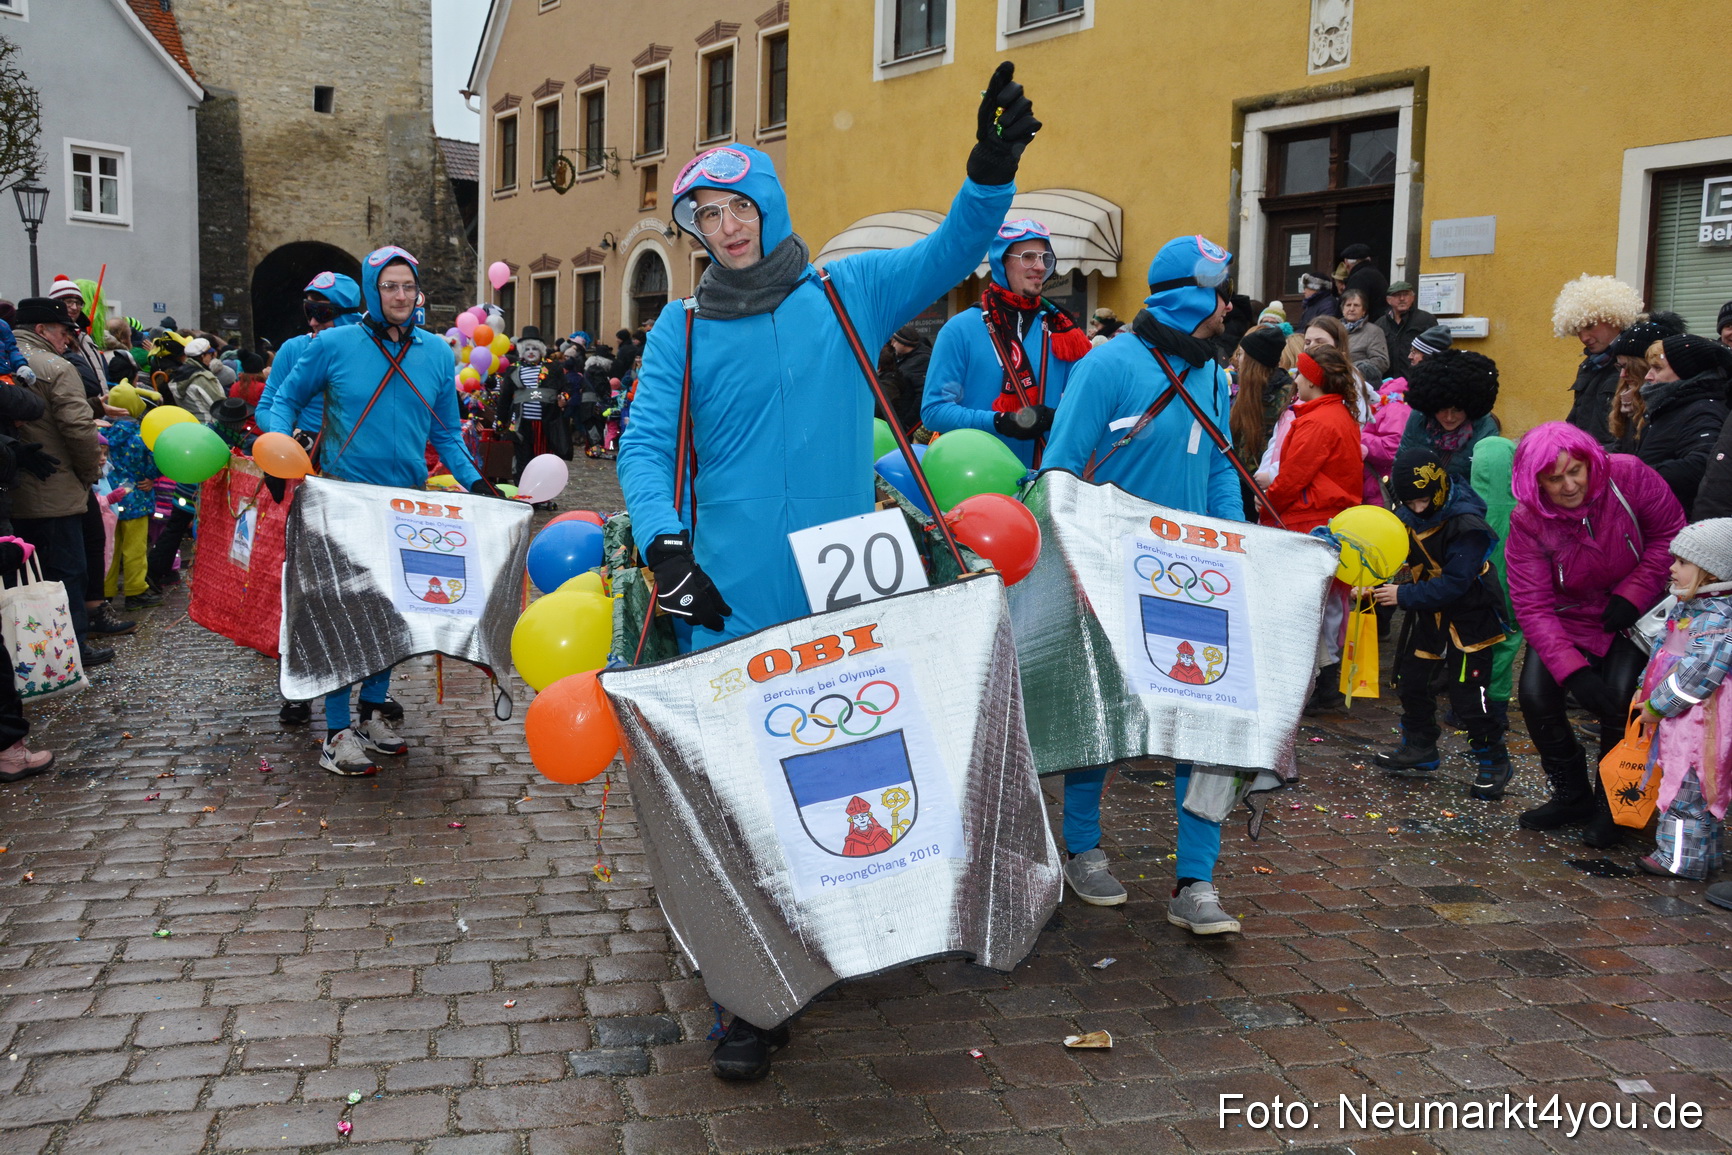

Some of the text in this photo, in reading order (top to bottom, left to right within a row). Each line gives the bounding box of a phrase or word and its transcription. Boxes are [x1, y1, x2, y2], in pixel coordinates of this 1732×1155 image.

[390, 498, 464, 520] OBI
[395, 515, 424, 526] Berching
[437, 521, 462, 530] Olympia
[1150, 516, 1247, 554] OBI
[1136, 542, 1225, 568] Berching bei Olympia
[818, 532, 904, 611] 20
[456, 608, 474, 616] 2018
[747, 623, 884, 683] OBI
[763, 665, 886, 703] Berching bei Olympia
[1150, 682, 1238, 704] PyeongChang 2018
[820, 843, 941, 887] PyeongChang 2018
